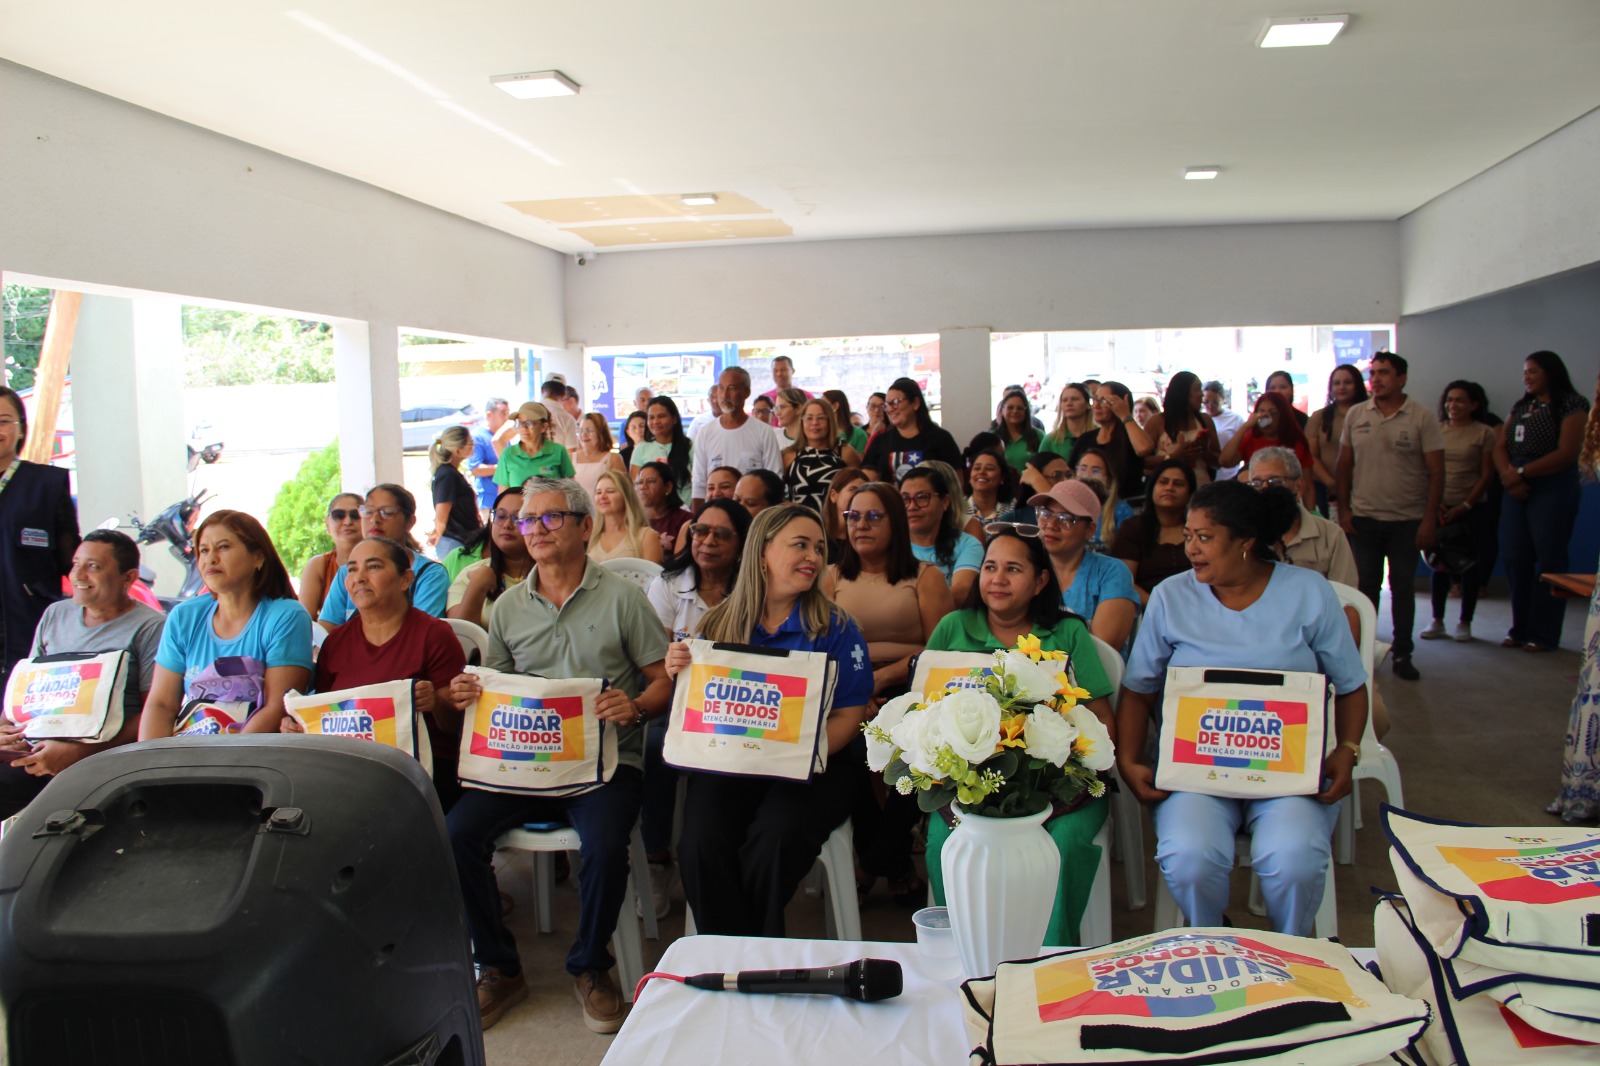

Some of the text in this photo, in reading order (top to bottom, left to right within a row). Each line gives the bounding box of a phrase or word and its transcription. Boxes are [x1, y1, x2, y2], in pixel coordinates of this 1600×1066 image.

[711, 676, 777, 690] PROGRAMA
[705, 682, 781, 707] CUIDAR
[497, 704, 556, 714] PROGRAMA
[703, 700, 778, 721] DE TODOS
[1207, 709, 1276, 718] PROGRAMA
[321, 716, 373, 733] CUIDAR
[491, 710, 561, 731] CUIDAR
[1200, 714, 1282, 736] CUIDAR
[489, 727, 562, 744] DE TODOS
[1198, 731, 1281, 750] DE TODOS
[1092, 945, 1226, 975] TODOS
[1096, 956, 1293, 990] CUIDAR
[1115, 975, 1285, 995] PROGRAMA
